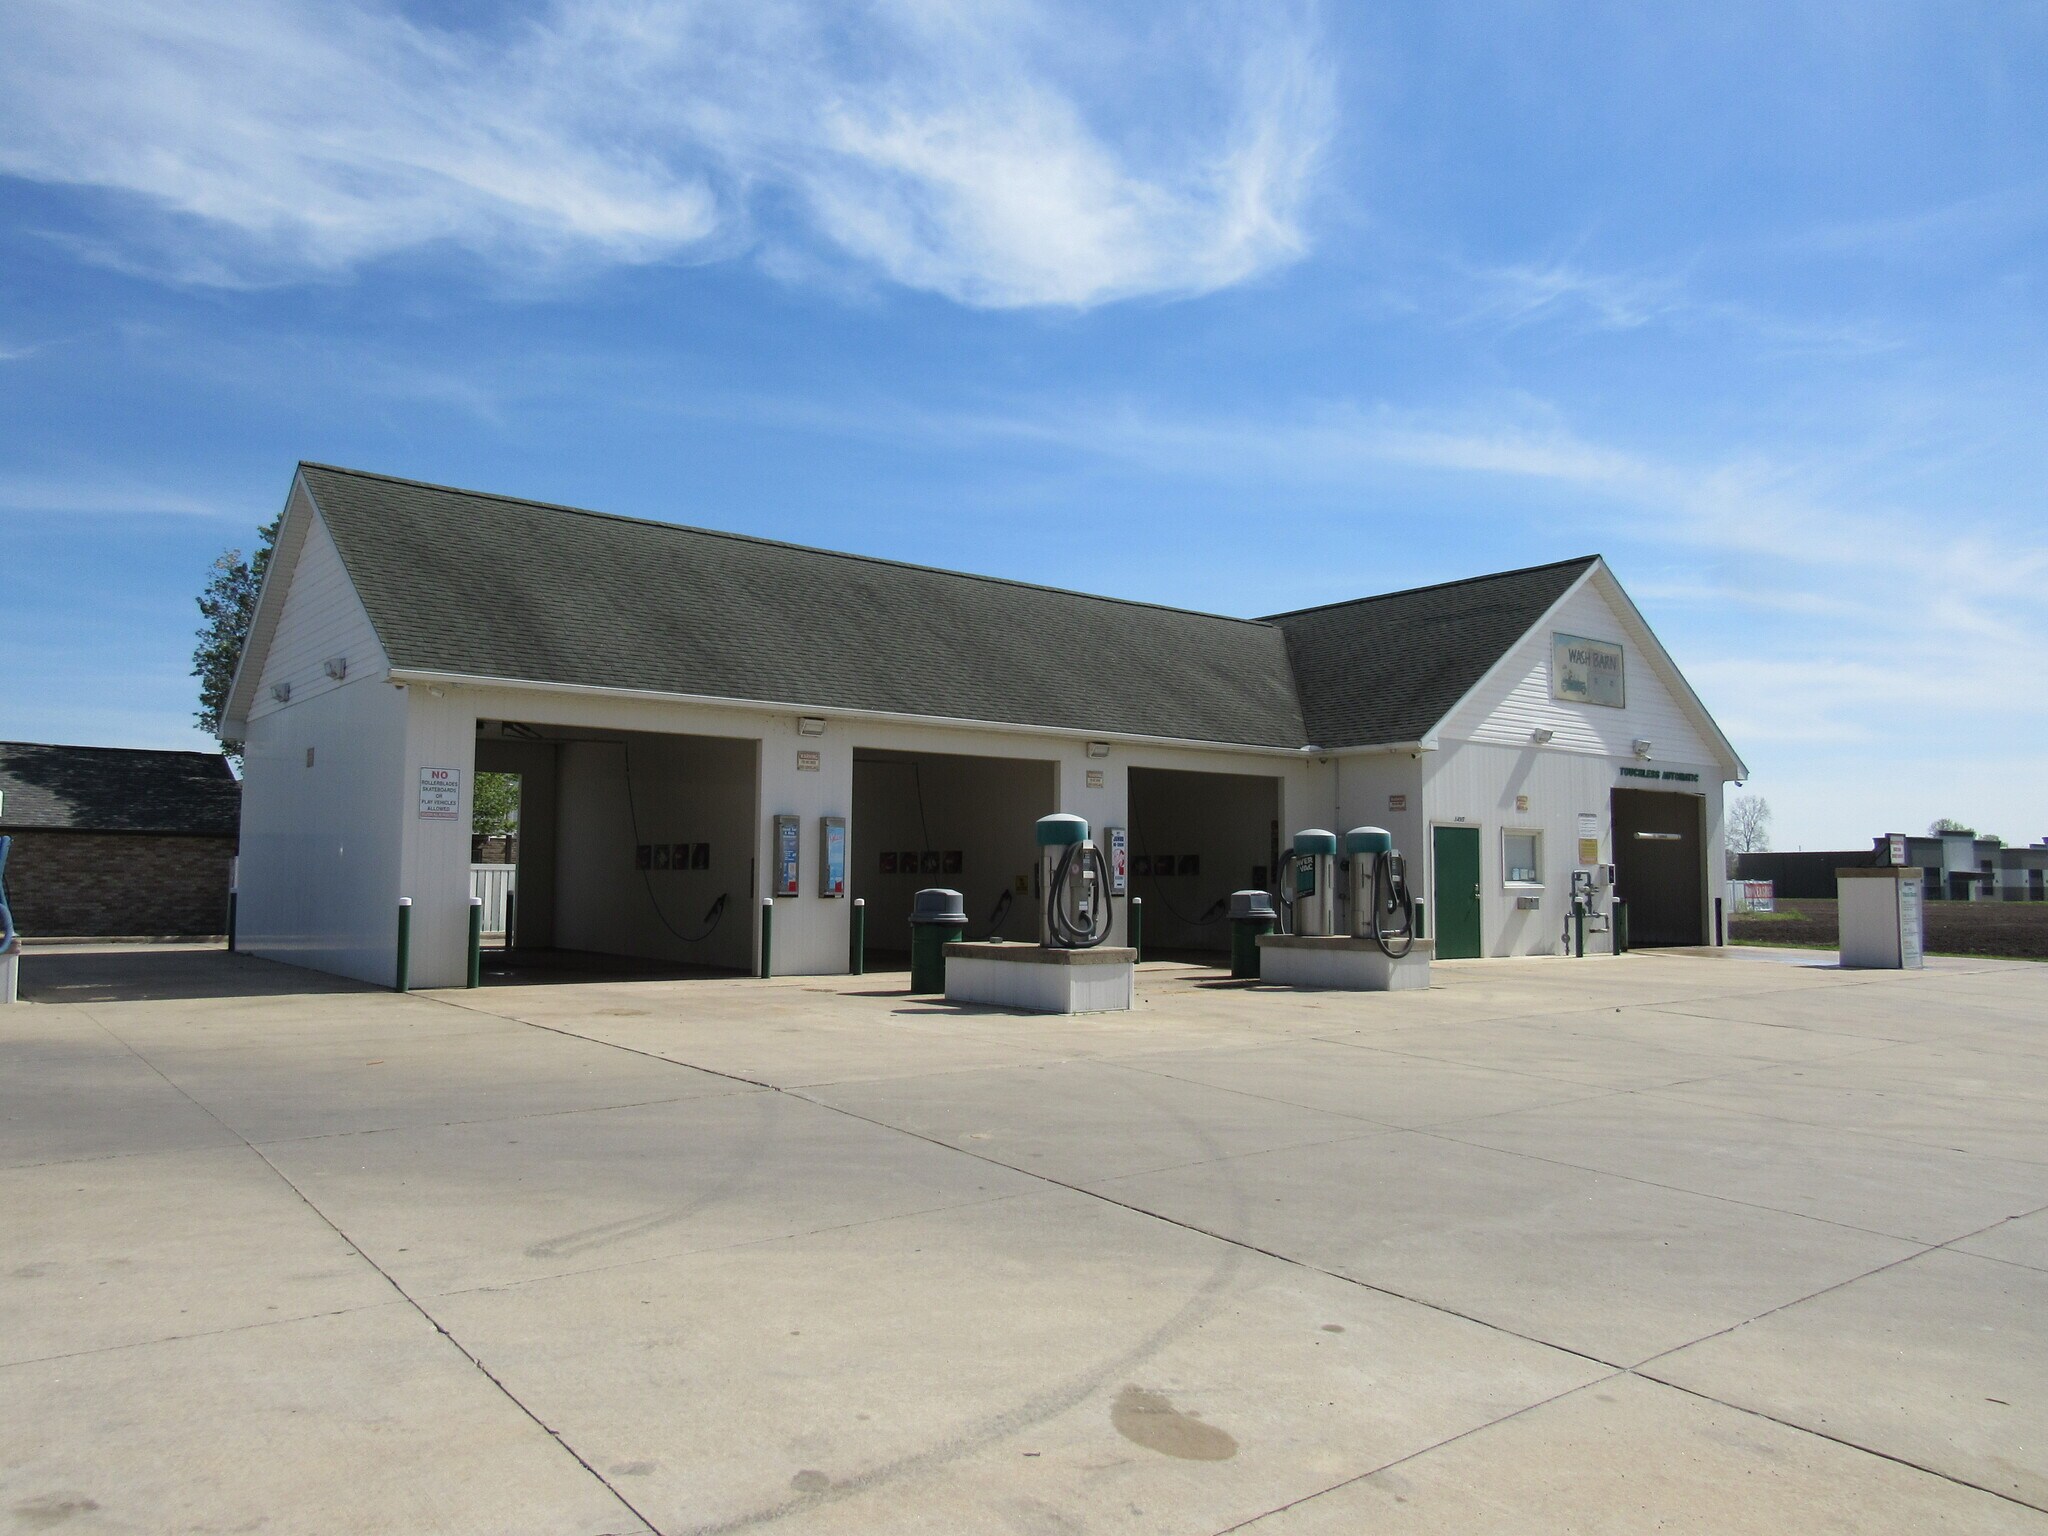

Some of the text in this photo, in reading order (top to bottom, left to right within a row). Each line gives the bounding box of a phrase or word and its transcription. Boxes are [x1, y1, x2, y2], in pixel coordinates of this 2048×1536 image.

[1569, 648, 1617, 671] WASH BARN
[431, 770, 449, 780] NO
[1619, 767, 1700, 783] TOUCHLESS AUTOMATIC
[421, 779, 458, 787] ROLLERBLADES
[1298, 863, 1313, 873] VAC
